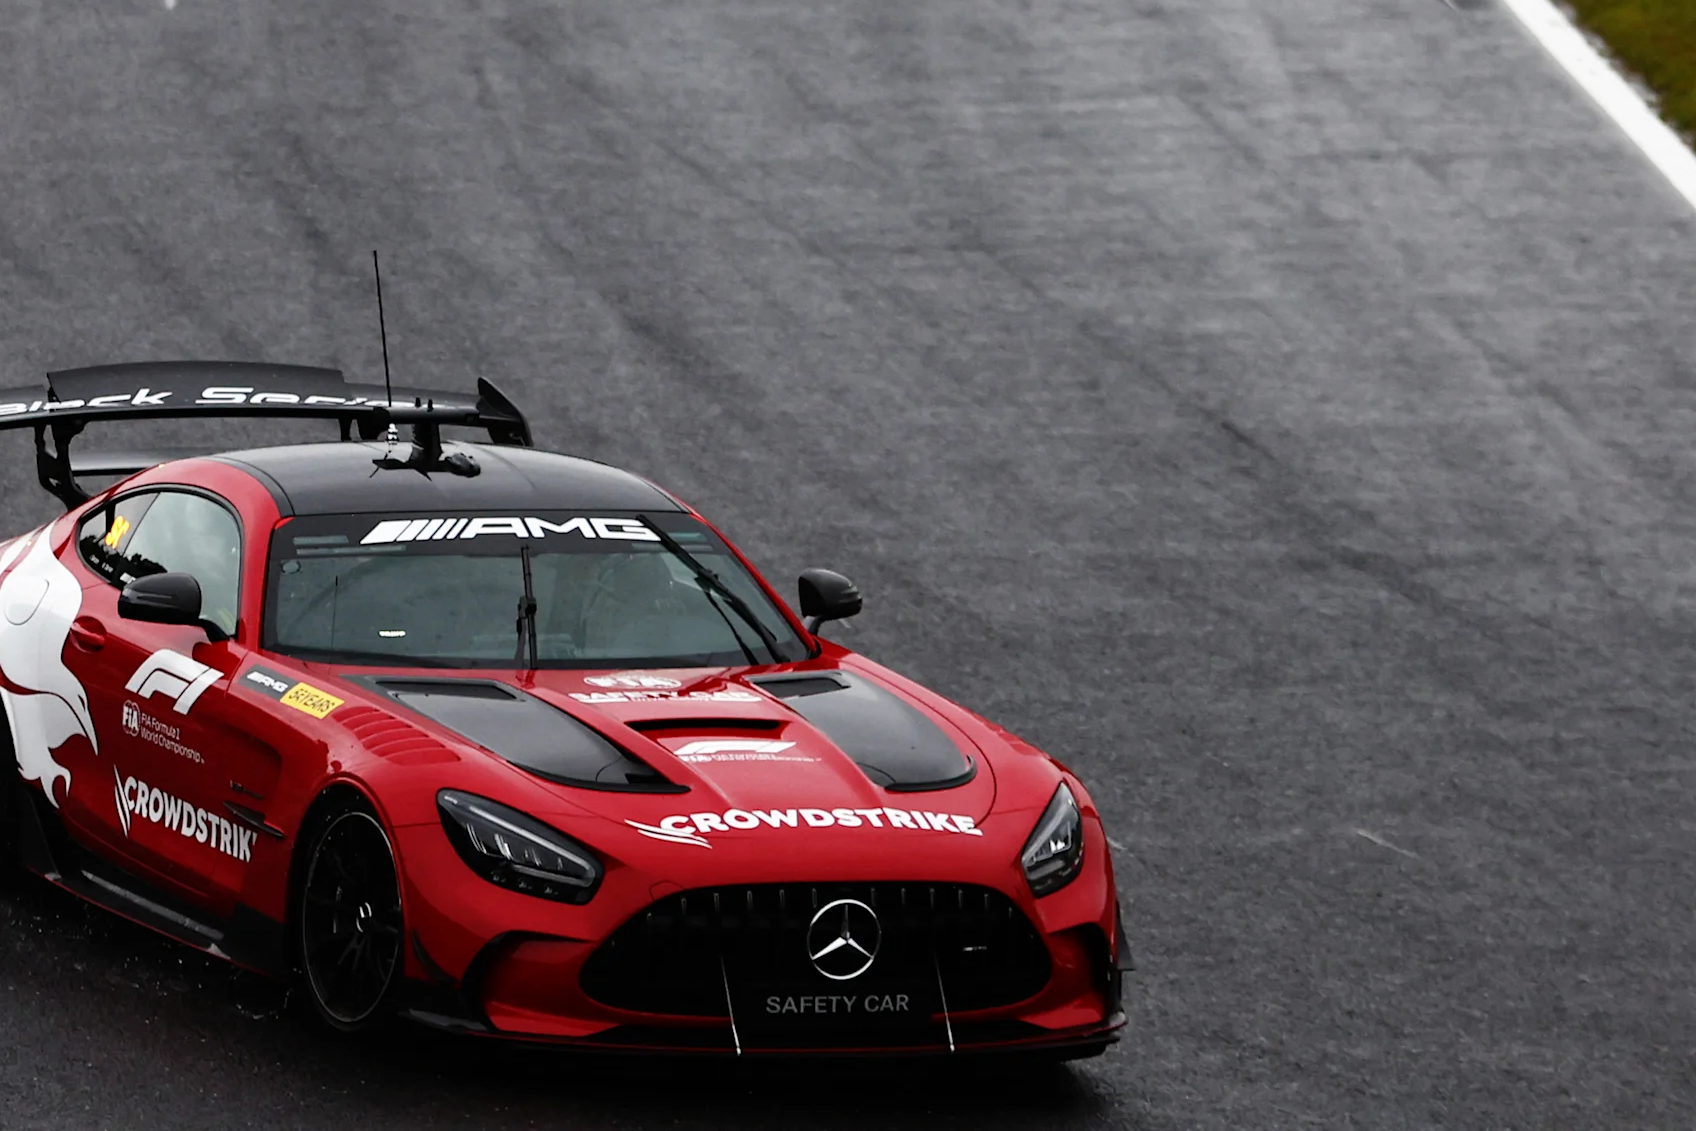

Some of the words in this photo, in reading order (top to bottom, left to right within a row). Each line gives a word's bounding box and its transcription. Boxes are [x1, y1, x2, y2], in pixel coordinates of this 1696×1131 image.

[141, 712, 152, 728] FIA
[151, 717, 176, 739] Formula
[140, 726, 159, 745] World
[158, 734, 202, 764] Championship
[124, 776, 258, 863] CROWDSTRIK
[659, 807, 984, 837] CROWDSTRIKE
[765, 995, 857, 1014] SAFETY
[863, 994, 909, 1012] CAR
